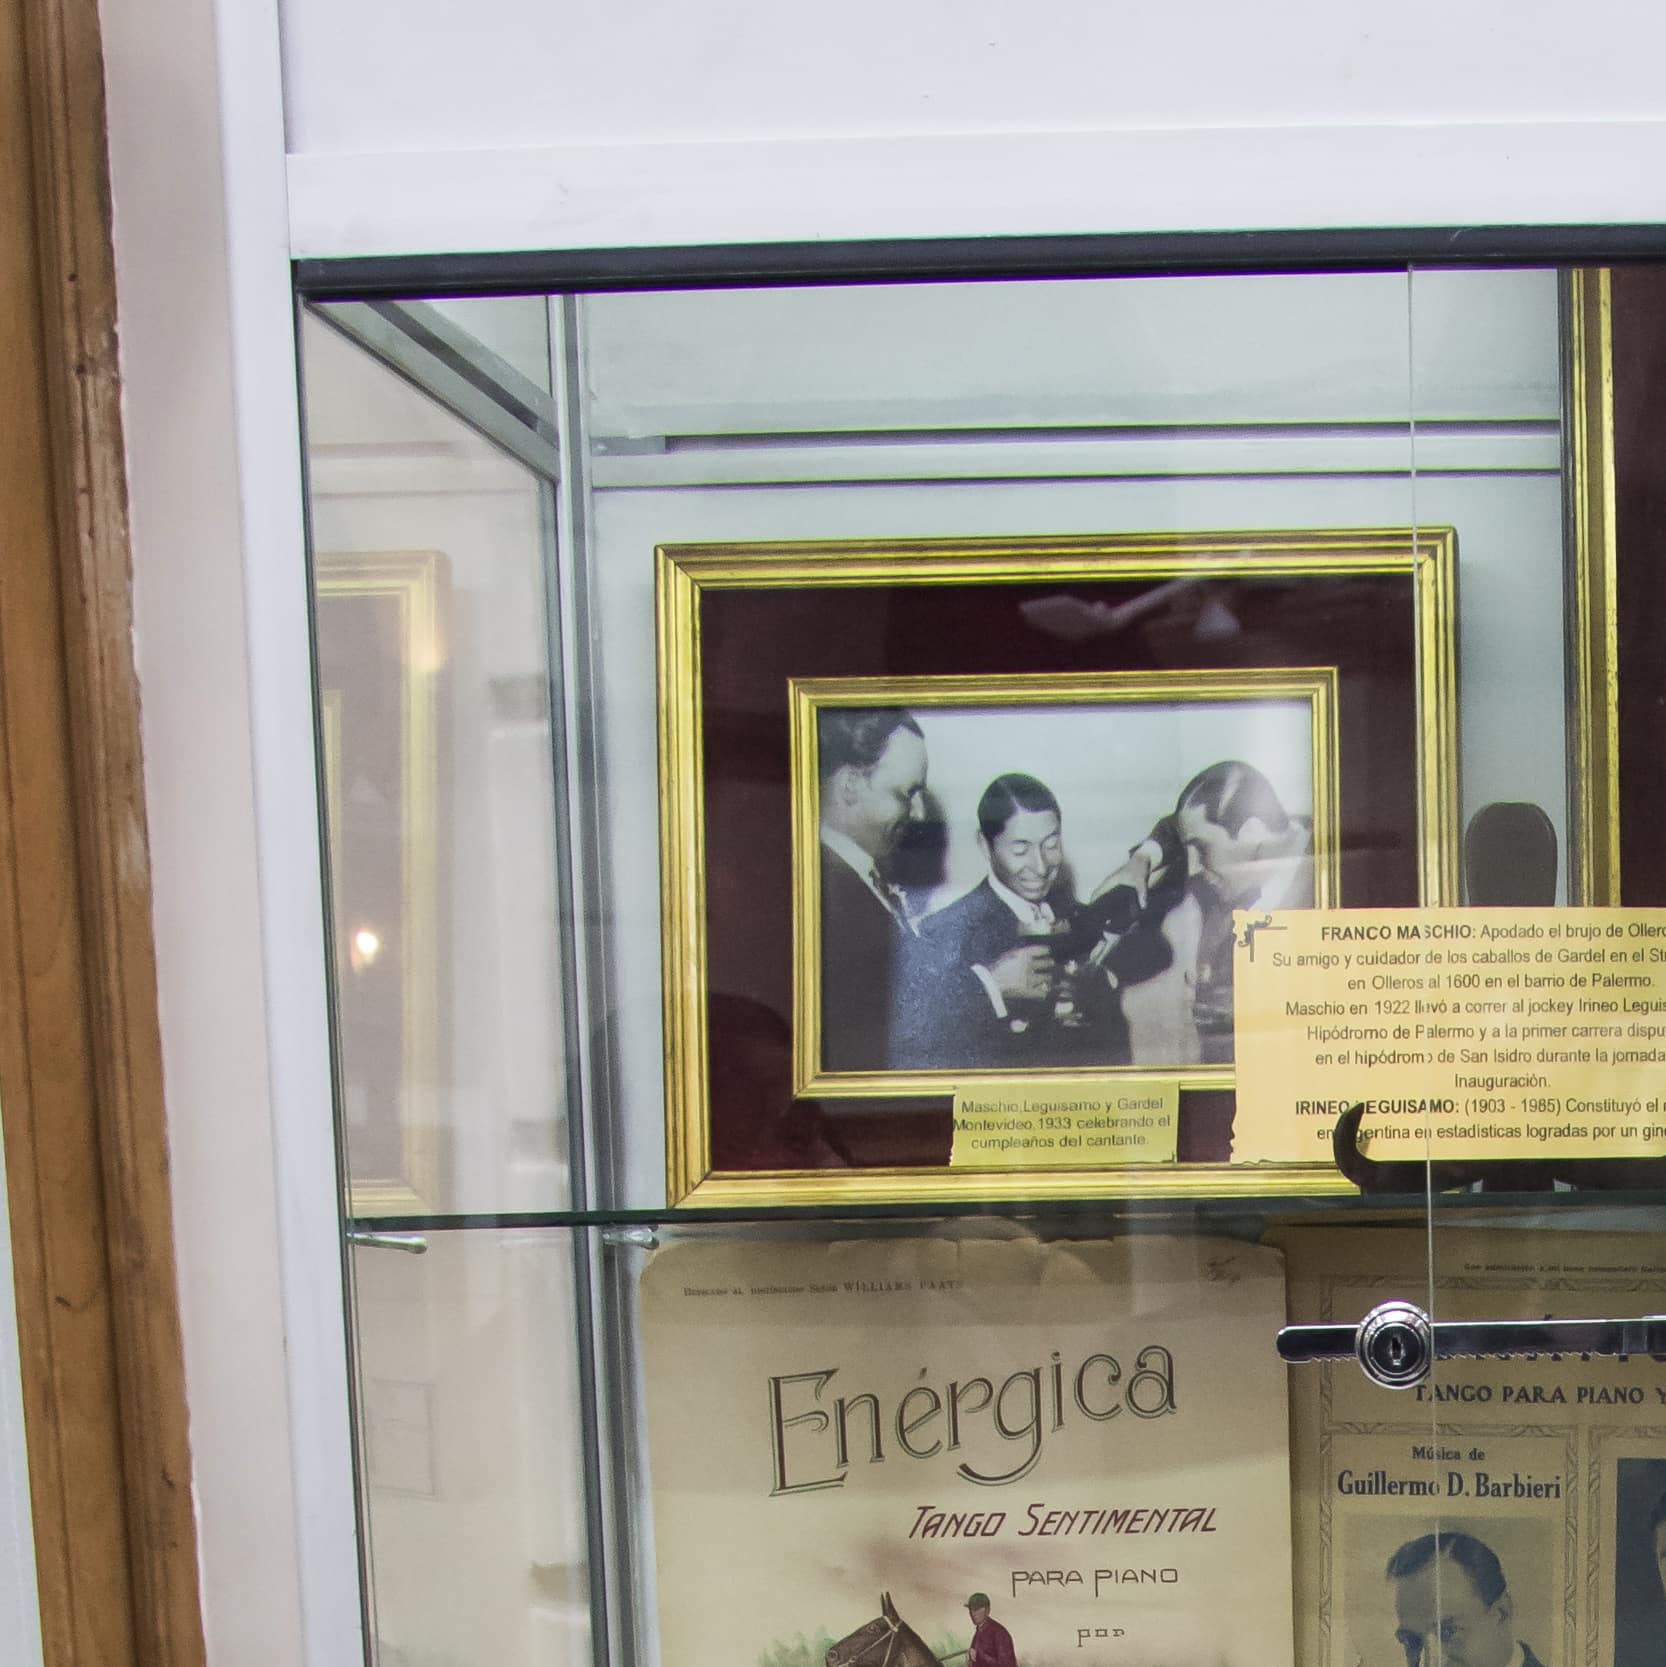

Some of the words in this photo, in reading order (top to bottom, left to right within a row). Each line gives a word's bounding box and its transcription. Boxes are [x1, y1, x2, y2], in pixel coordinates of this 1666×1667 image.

[1321, 926, 1391, 940] FRANCO
[1397, 924, 1480, 940] MASCHIO:
[1480, 924, 1544, 942] Apodado
[1549, 923, 1561, 938] el
[1566, 923, 1601, 941] brujo
[1606, 923, 1623, 937] de
[1273, 952, 1291, 967] Su
[1296, 952, 1339, 969] amigo
[1356, 951, 1420, 965] cuidador
[1425, 950, 1442, 964] de
[1447, 950, 1467, 964] los
[1472, 949, 1530, 964] caballos
[1535, 949, 1552, 963] de
[1557, 948, 1605, 963] Gardel
[1610, 952, 1627, 963] en
[1632, 948, 1644, 963] el
[1347, 978, 1365, 990] en
[1372, 975, 1424, 989] Olleros
[1429, 974, 1441, 989] al
[1446, 974, 1481, 988] 1600
[1485, 977, 1502, 988] en
[1507, 974, 1519, 988] el
[1524, 973, 1565, 987] barrio
[1569, 973, 1587, 987] de
[1592, 972, 1655, 987] Palermo.
[1286, 1001, 1345, 1016] Maschio
[1350, 1003, 1368, 1015] en
[1375, 1000, 1410, 1015] 1922
[1465, 1001, 1507, 1013] correr
[1512, 998, 1524, 1013] al
[1528, 998, 1573, 1016] jockey
[1579, 998, 1618, 1013] Irineo
[1307, 1025, 1388, 1043] Hipódromo
[1393, 1025, 1410, 1039] de
[1415, 1024, 1474, 1039] Palermo
[1505, 1023, 1517, 1038] la
[1522, 1023, 1567, 1041] primer
[1571, 1026, 1623, 1037] carrera
[1315, 1053, 1333, 1065] en
[1338, 1050, 1350, 1064] el
[1355, 1050, 1433, 1068] hipódromo
[1437, 1049, 1455, 1063] de
[1460, 1049, 1488, 1063] San
[1494, 1049, 1532, 1063] Isidro
[1536, 1048, 1590, 1062] durante
[1596, 1048, 1608, 1062] la
[1612, 1048, 1666, 1065] jornada
[1455, 1073, 1551, 1091] Inauguración.
[1117, 1097, 1163, 1111] Gardel
[1296, 1100, 1350, 1115] IRINEO
[1465, 1097, 1506, 1116] (1903
[1521, 1097, 1561, 1116] 1985)
[1566, 1097, 1642, 1116] Constituyó
[1646, 1097, 1659, 1112] el
[1076, 1115, 1154, 1130] celebrando
[1158, 1114, 1170, 1127] el
[1437, 1124, 1522, 1139] estadísticas
[1527, 1123, 1588, 1142] logradas
[1593, 1126, 1615, 1141] por
[1621, 1126, 1637, 1137] un
[971, 1135, 1054, 1151] cumpleaños
[1058, 1135, 1082, 1147] del
[1086, 1134, 1149, 1147] cantante.
[1415, 1384, 1493, 1403] TANGO
[1503, 1384, 1567, 1403] PARA
[1577, 1385, 1644, 1404] PIANO
[768, 1343, 1178, 1497] Enérgica
[1412, 1446, 1461, 1462] Música
[1468, 1446, 1485, 1460] de
[1337, 1470, 1439, 1499] Guillermo
[1447, 1472, 1471, 1498] D.
[1475, 1472, 1561, 1499] Barbieri
[908, 1505, 1006, 1538] TANGO
[1017, 1503, 1218, 1537] SENTIMENTAL
[1012, 1570, 1084, 1598] PARA
[1094, 1568, 1179, 1598] PIANO
